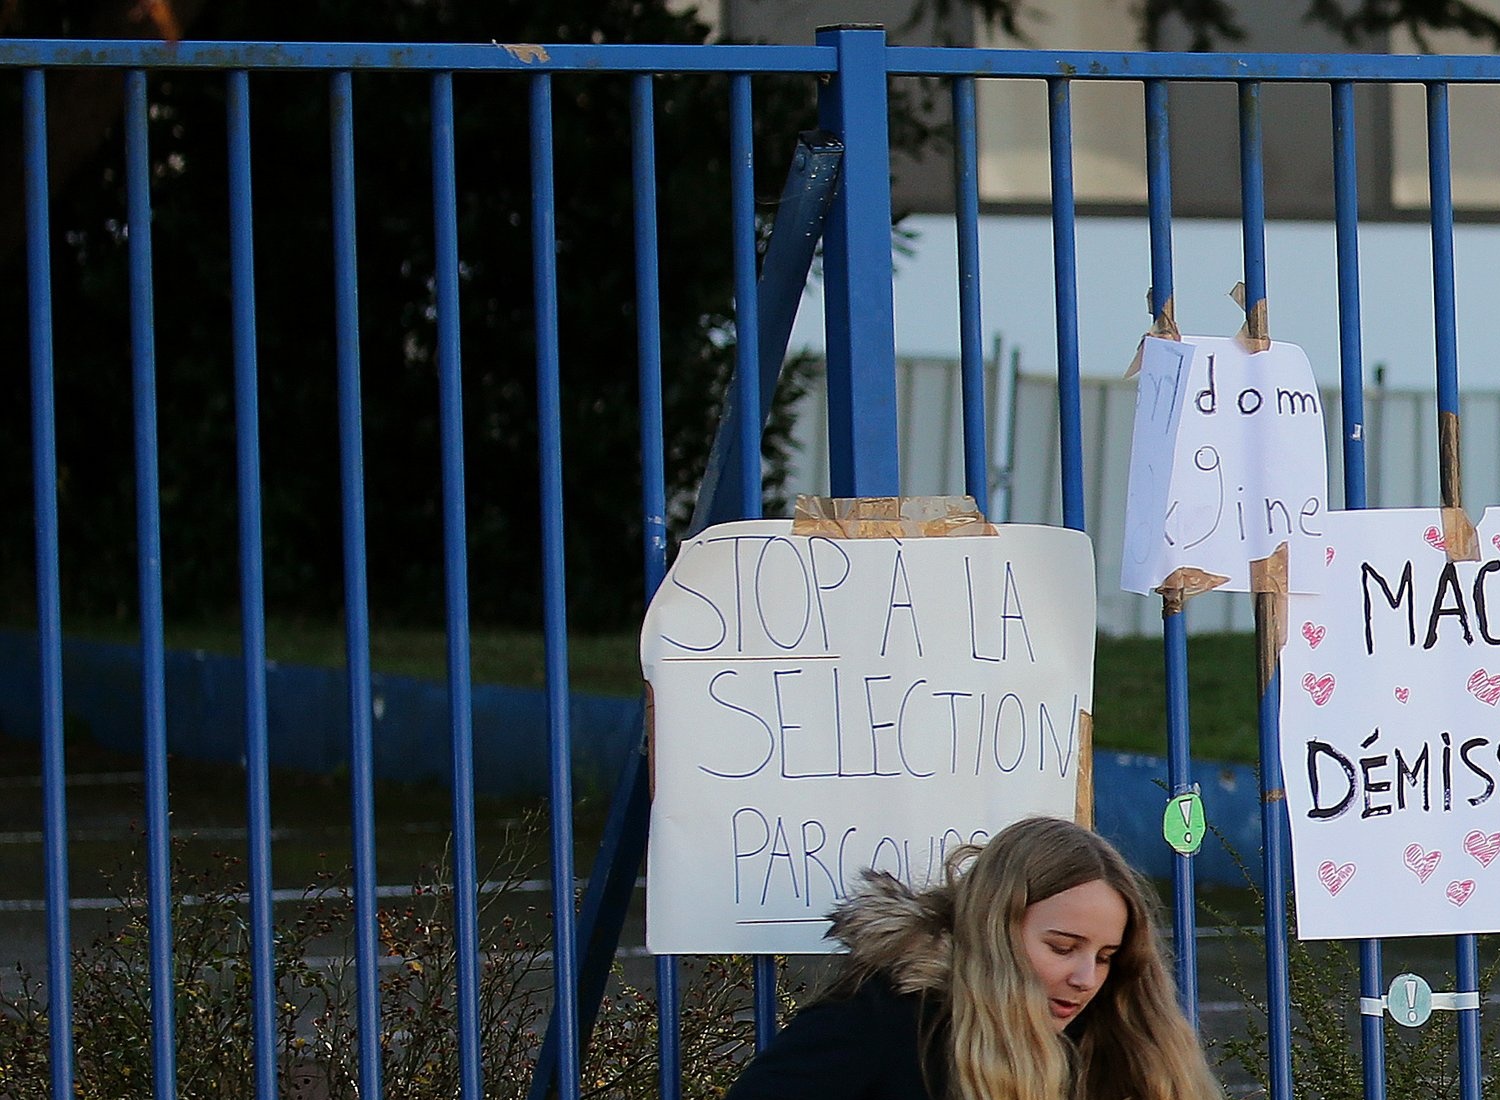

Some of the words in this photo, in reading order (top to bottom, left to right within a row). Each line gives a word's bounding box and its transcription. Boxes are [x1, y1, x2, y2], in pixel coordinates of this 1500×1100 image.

[660, 535, 851, 652] STOP
[880, 535, 923, 658] À
[964, 556, 1035, 663] LA
[697, 667, 1079, 779] SELECTION
